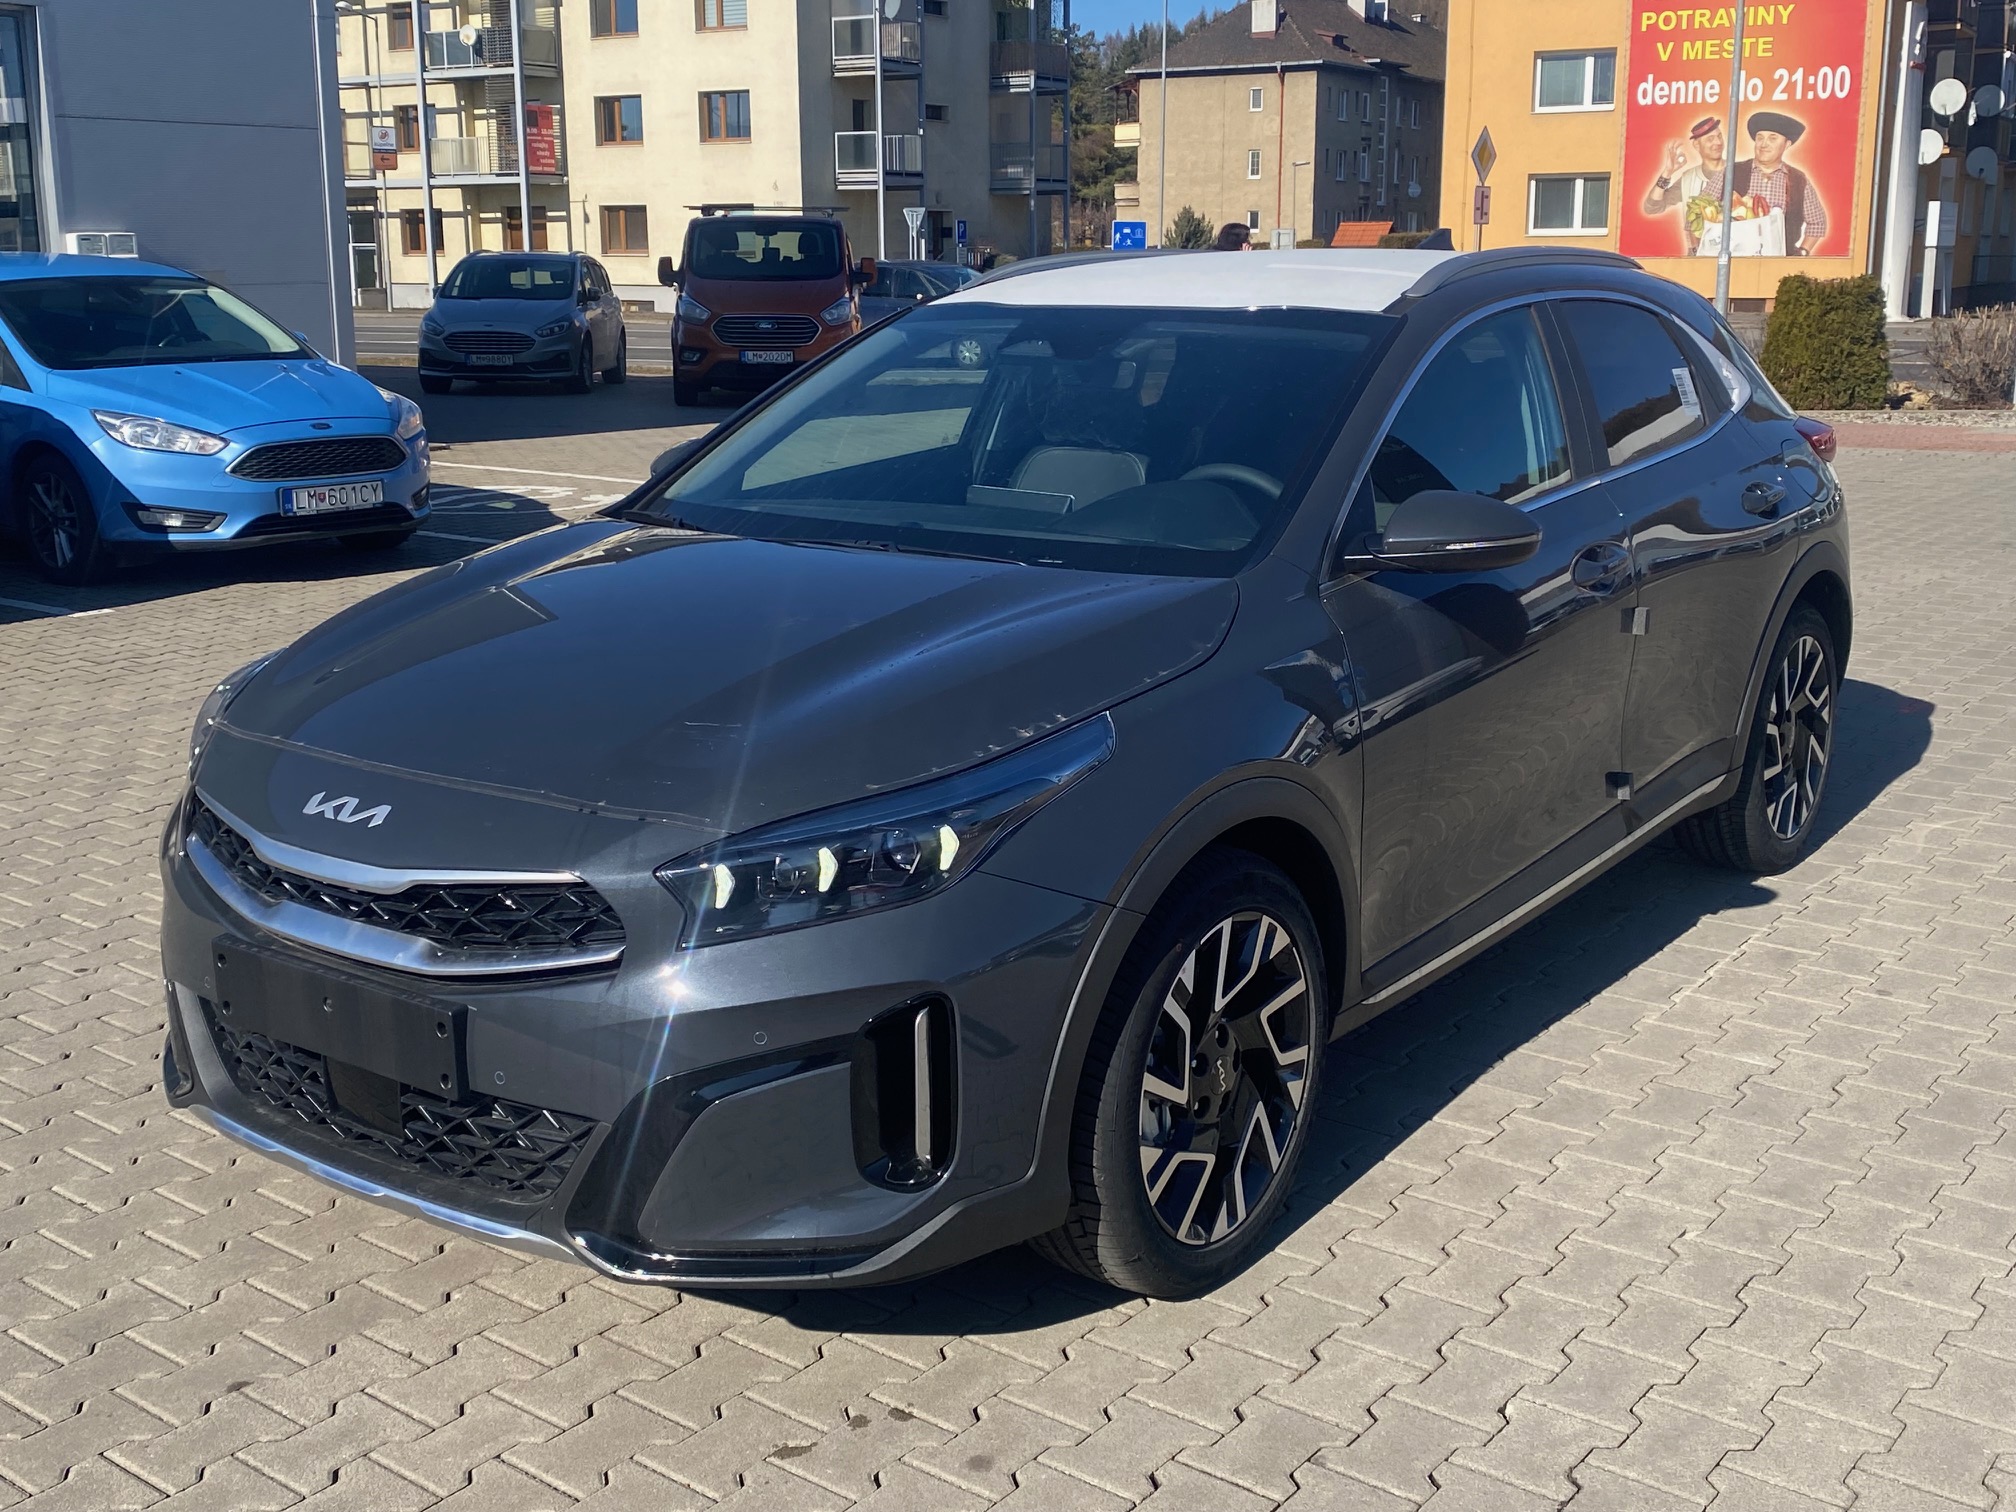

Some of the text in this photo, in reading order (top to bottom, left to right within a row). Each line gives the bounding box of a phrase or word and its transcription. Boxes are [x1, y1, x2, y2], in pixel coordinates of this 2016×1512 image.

[1656, 36, 1774, 62] V MESTE
[1637, 73, 1721, 106] denne
[1772, 65, 1851, 100] 21:00
[959, 222, 965, 237] P
[294, 483, 379, 510] LM 601CY
[302, 791, 392, 828] KIA
